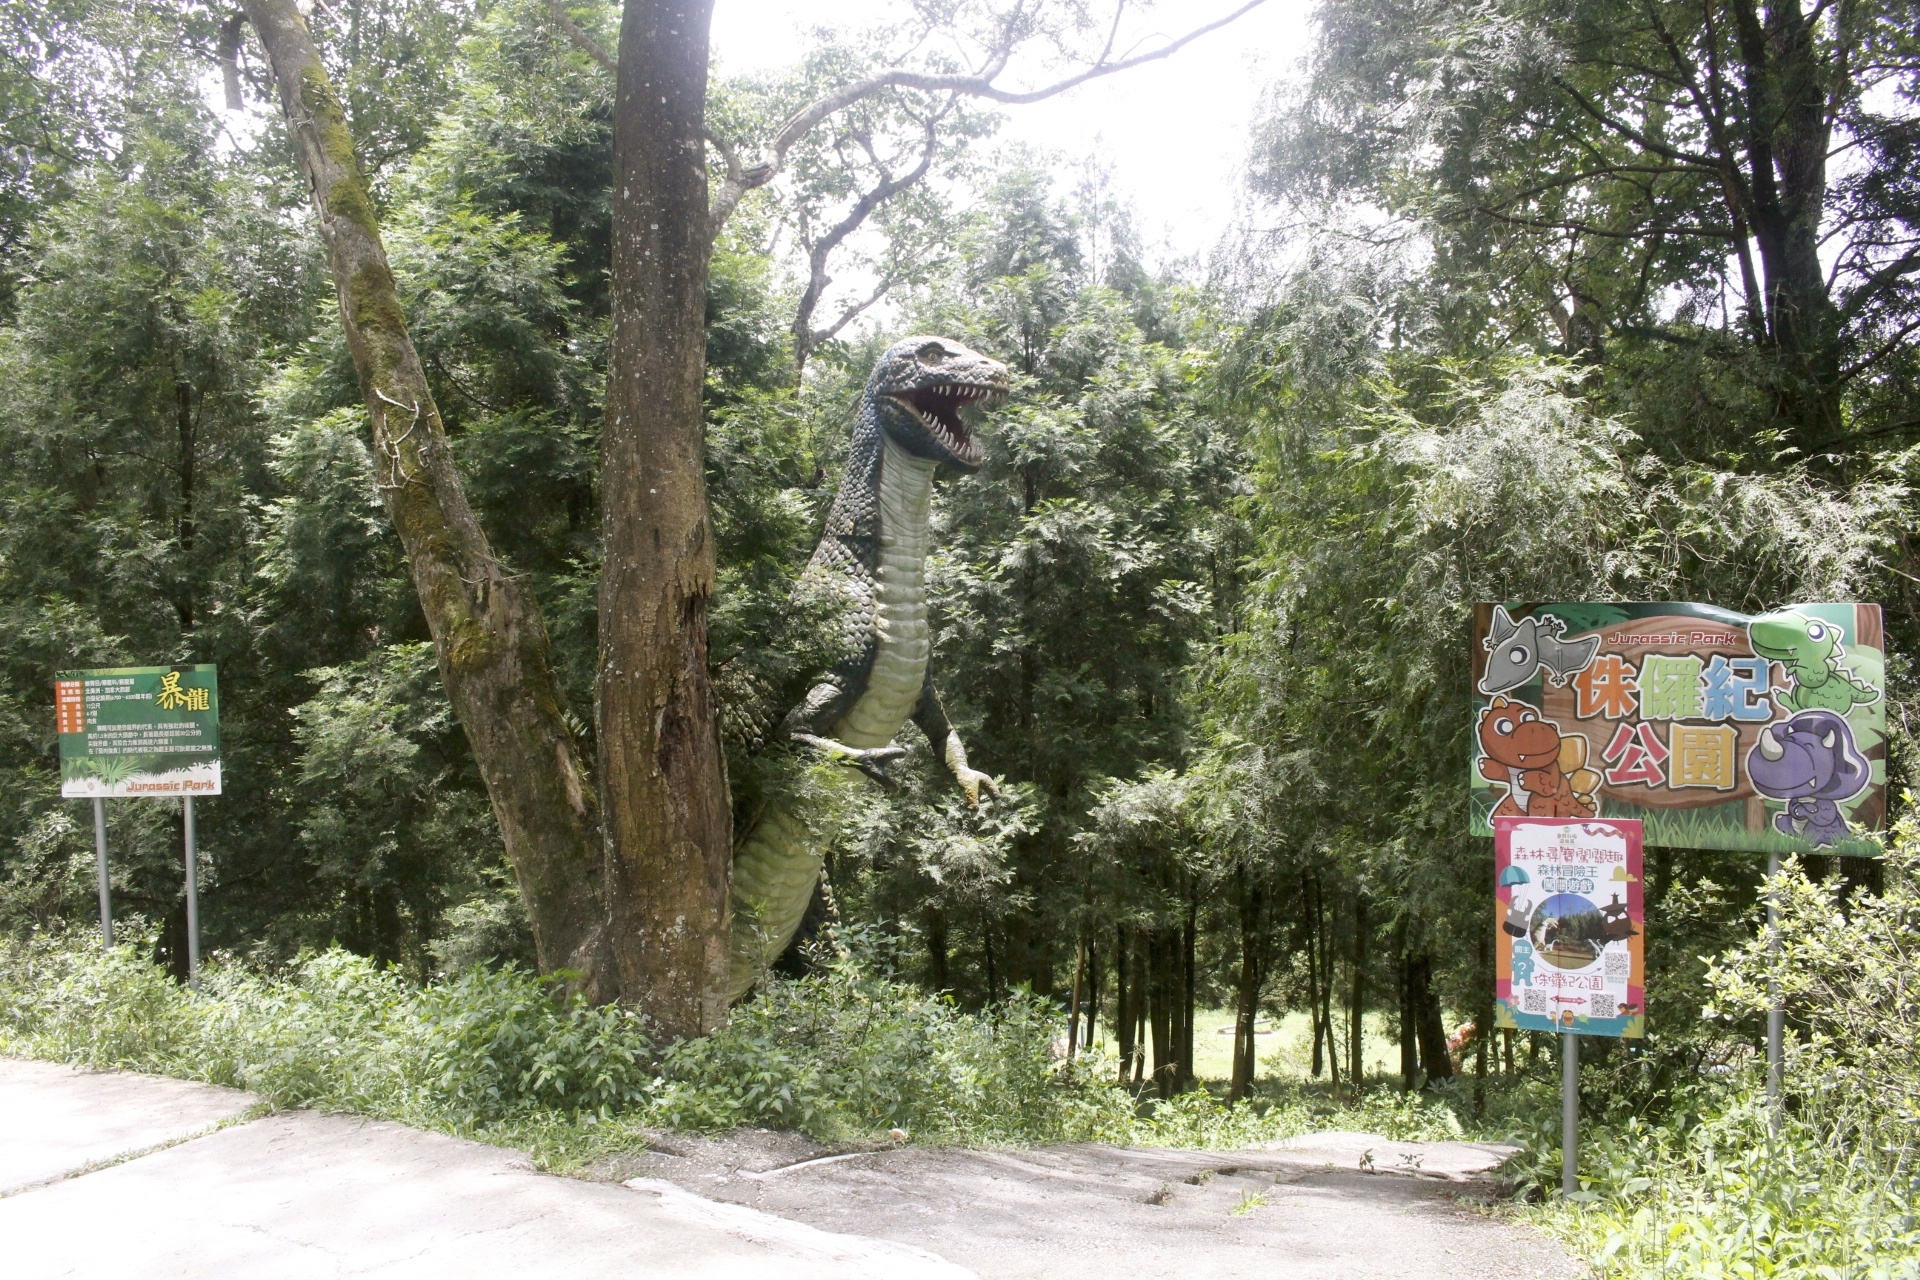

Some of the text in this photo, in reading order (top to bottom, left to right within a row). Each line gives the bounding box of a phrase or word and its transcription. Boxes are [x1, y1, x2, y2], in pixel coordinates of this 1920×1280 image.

[1608, 632, 1736, 646] Jurassic Park
[155, 671, 210, 711] 暴龍
[1573, 653, 1773, 721] 侏儸紀
[1604, 722, 1738, 789] 公園
[126, 780, 215, 792] Jurassic Park
[1514, 846, 1624, 864] 森林尋寶闖關趣
[1537, 865, 1598, 878] 森林冒險王
[1543, 877, 1593, 894] 闖關遊戲
